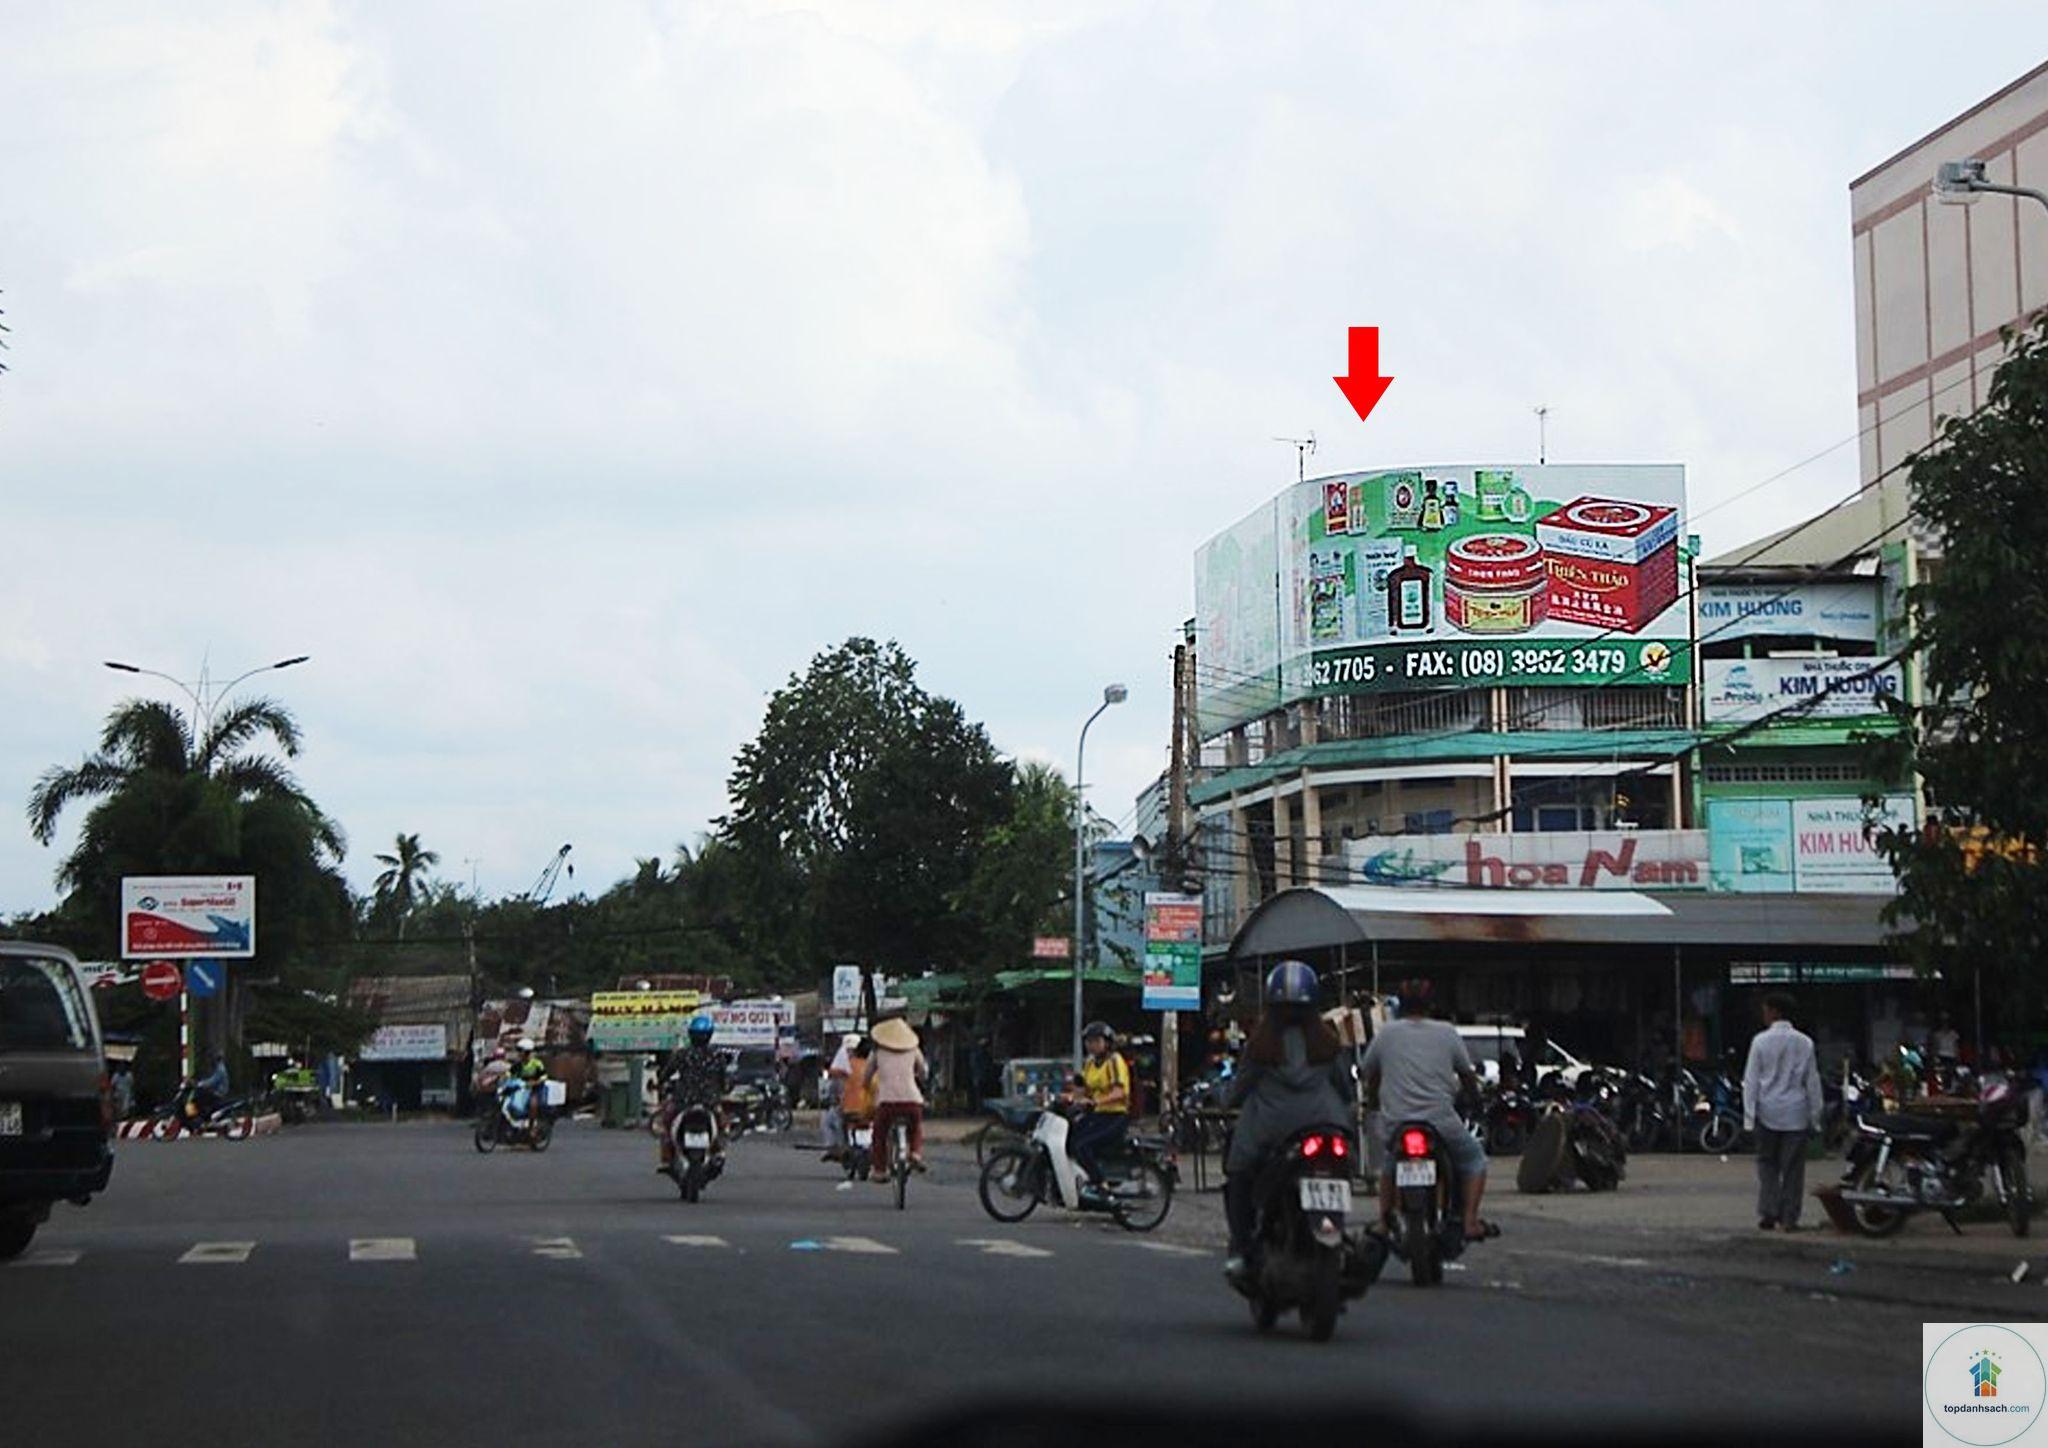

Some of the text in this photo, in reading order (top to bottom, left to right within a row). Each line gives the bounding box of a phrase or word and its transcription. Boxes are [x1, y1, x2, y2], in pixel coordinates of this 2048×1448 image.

[1698, 602, 1731, 618] KIM
[1334, 656, 1375, 683] 7705
[1406, 651, 1454, 676] FAX:
[1461, 650, 1504, 677] (08)
[1571, 650, 1626, 674] 3479
[1780, 676, 1818, 696] KIM
[1800, 832, 1834, 854] KIM
[1580, 838, 1699, 887] Nam
